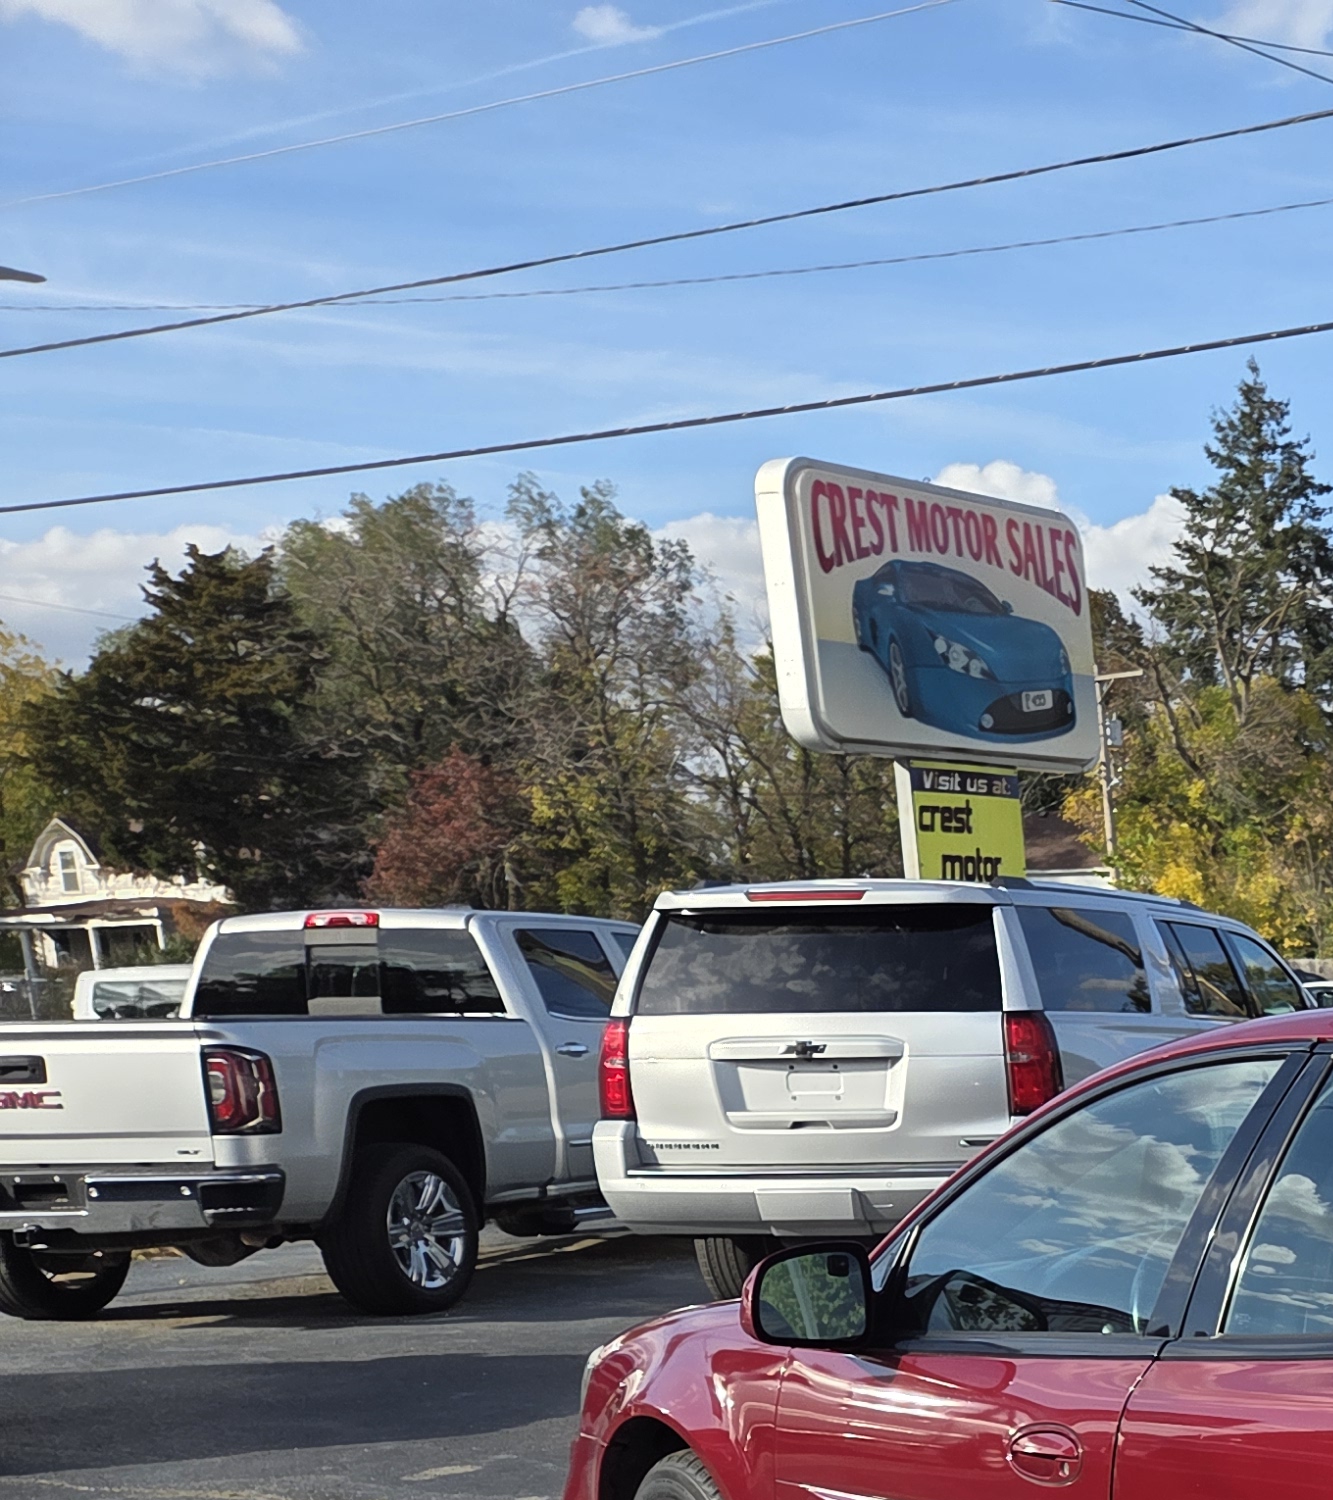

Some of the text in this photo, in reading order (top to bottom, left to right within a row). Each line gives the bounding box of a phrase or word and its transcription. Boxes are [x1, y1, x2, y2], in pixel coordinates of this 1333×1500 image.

[811, 479, 1082, 616] CREST MOTOR SALES
[923, 770, 961, 791] Visit
[966, 777, 988, 793] us
[919, 799, 973, 834] crest
[941, 847, 1002, 882] motor
